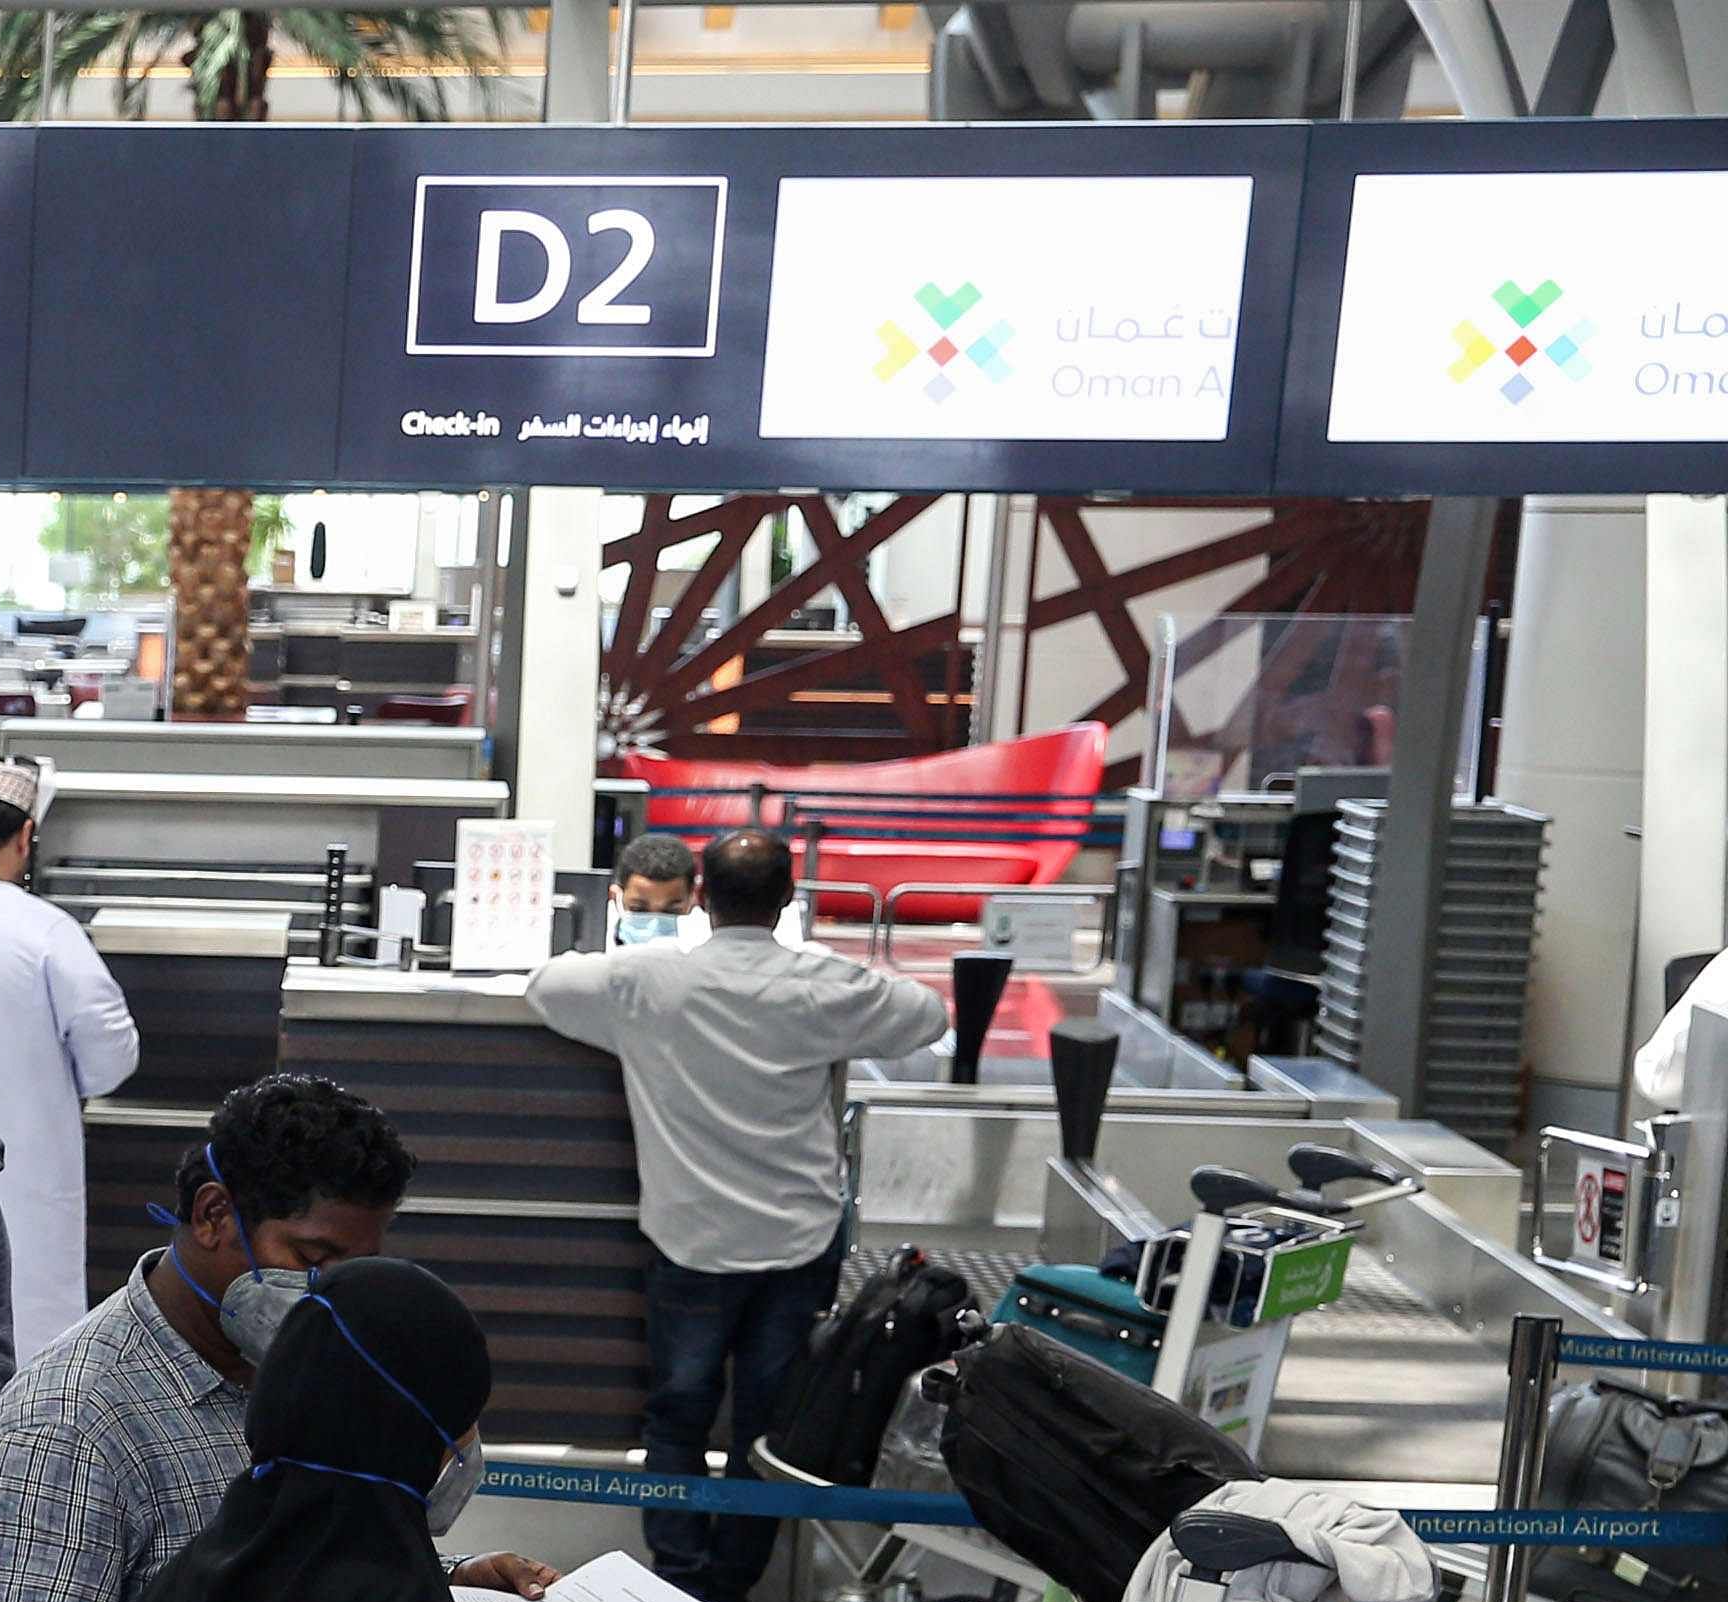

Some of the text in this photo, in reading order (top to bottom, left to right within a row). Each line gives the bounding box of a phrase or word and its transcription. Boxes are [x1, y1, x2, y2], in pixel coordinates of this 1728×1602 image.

[475, 209, 654, 323] D2
[1052, 365, 1225, 397] Oman A
[1635, 362, 1728, 396] Om
[402, 411, 500, 435] Check-in
[1560, 1339, 1728, 1367] Muscat Internatio
[482, 1472, 599, 1493] ternational
[607, 1477, 687, 1500] Airport
[1415, 1516, 1660, 1541] International Airport
